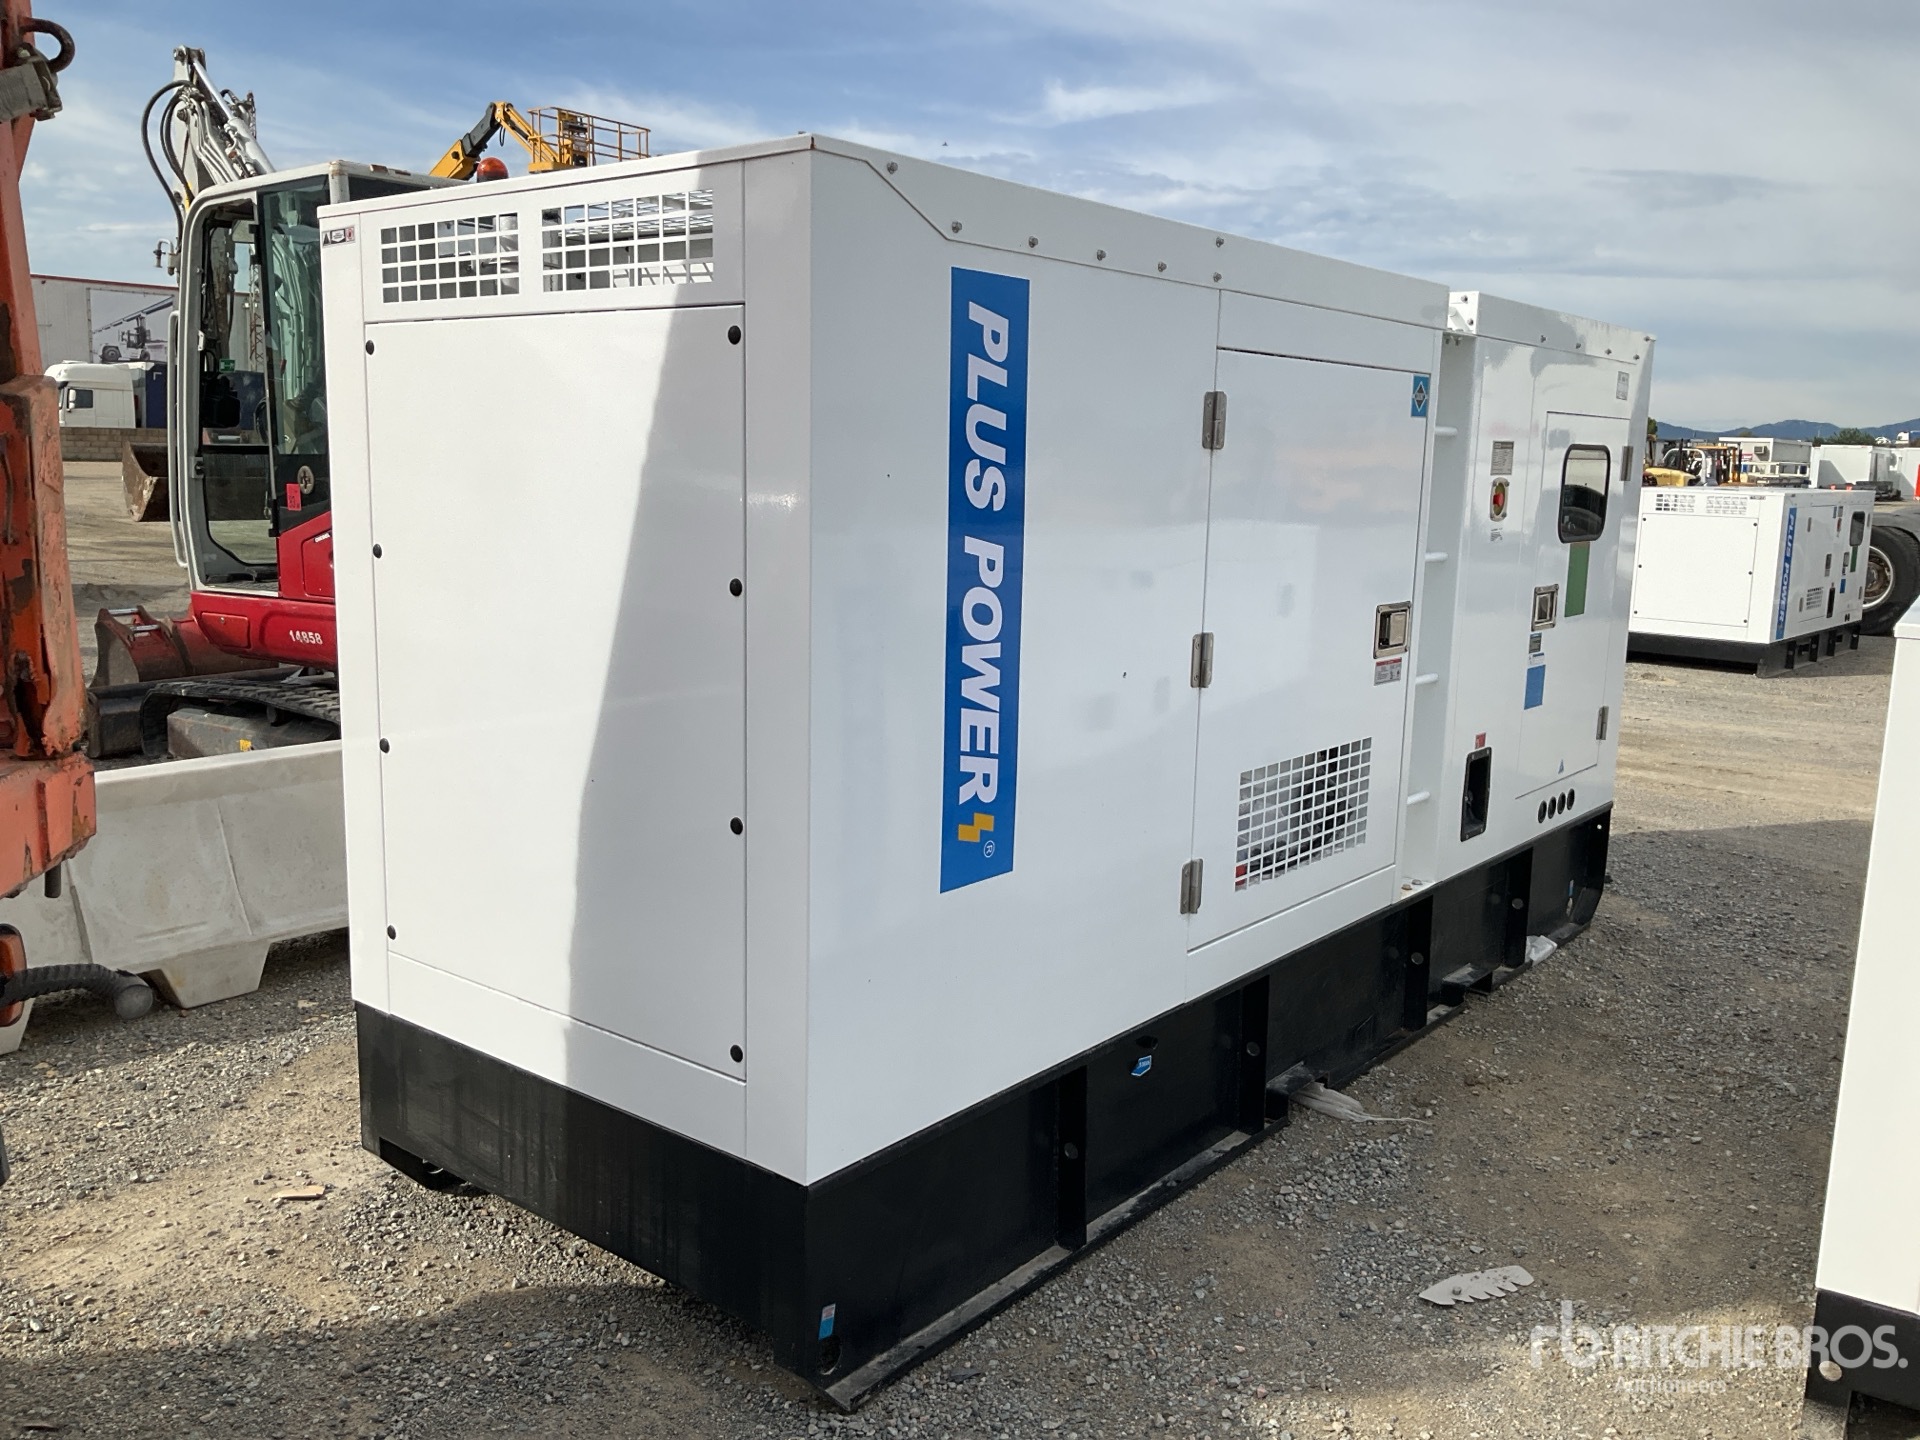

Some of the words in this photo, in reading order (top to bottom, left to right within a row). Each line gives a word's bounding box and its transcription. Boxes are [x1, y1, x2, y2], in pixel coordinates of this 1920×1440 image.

[964, 301, 1009, 512] PLUS
[1785, 514, 1795, 557] PLUS
[1779, 562, 1790, 622] POWER
[289, 630, 323, 645] 14858
[958, 535, 1004, 805] POWER
